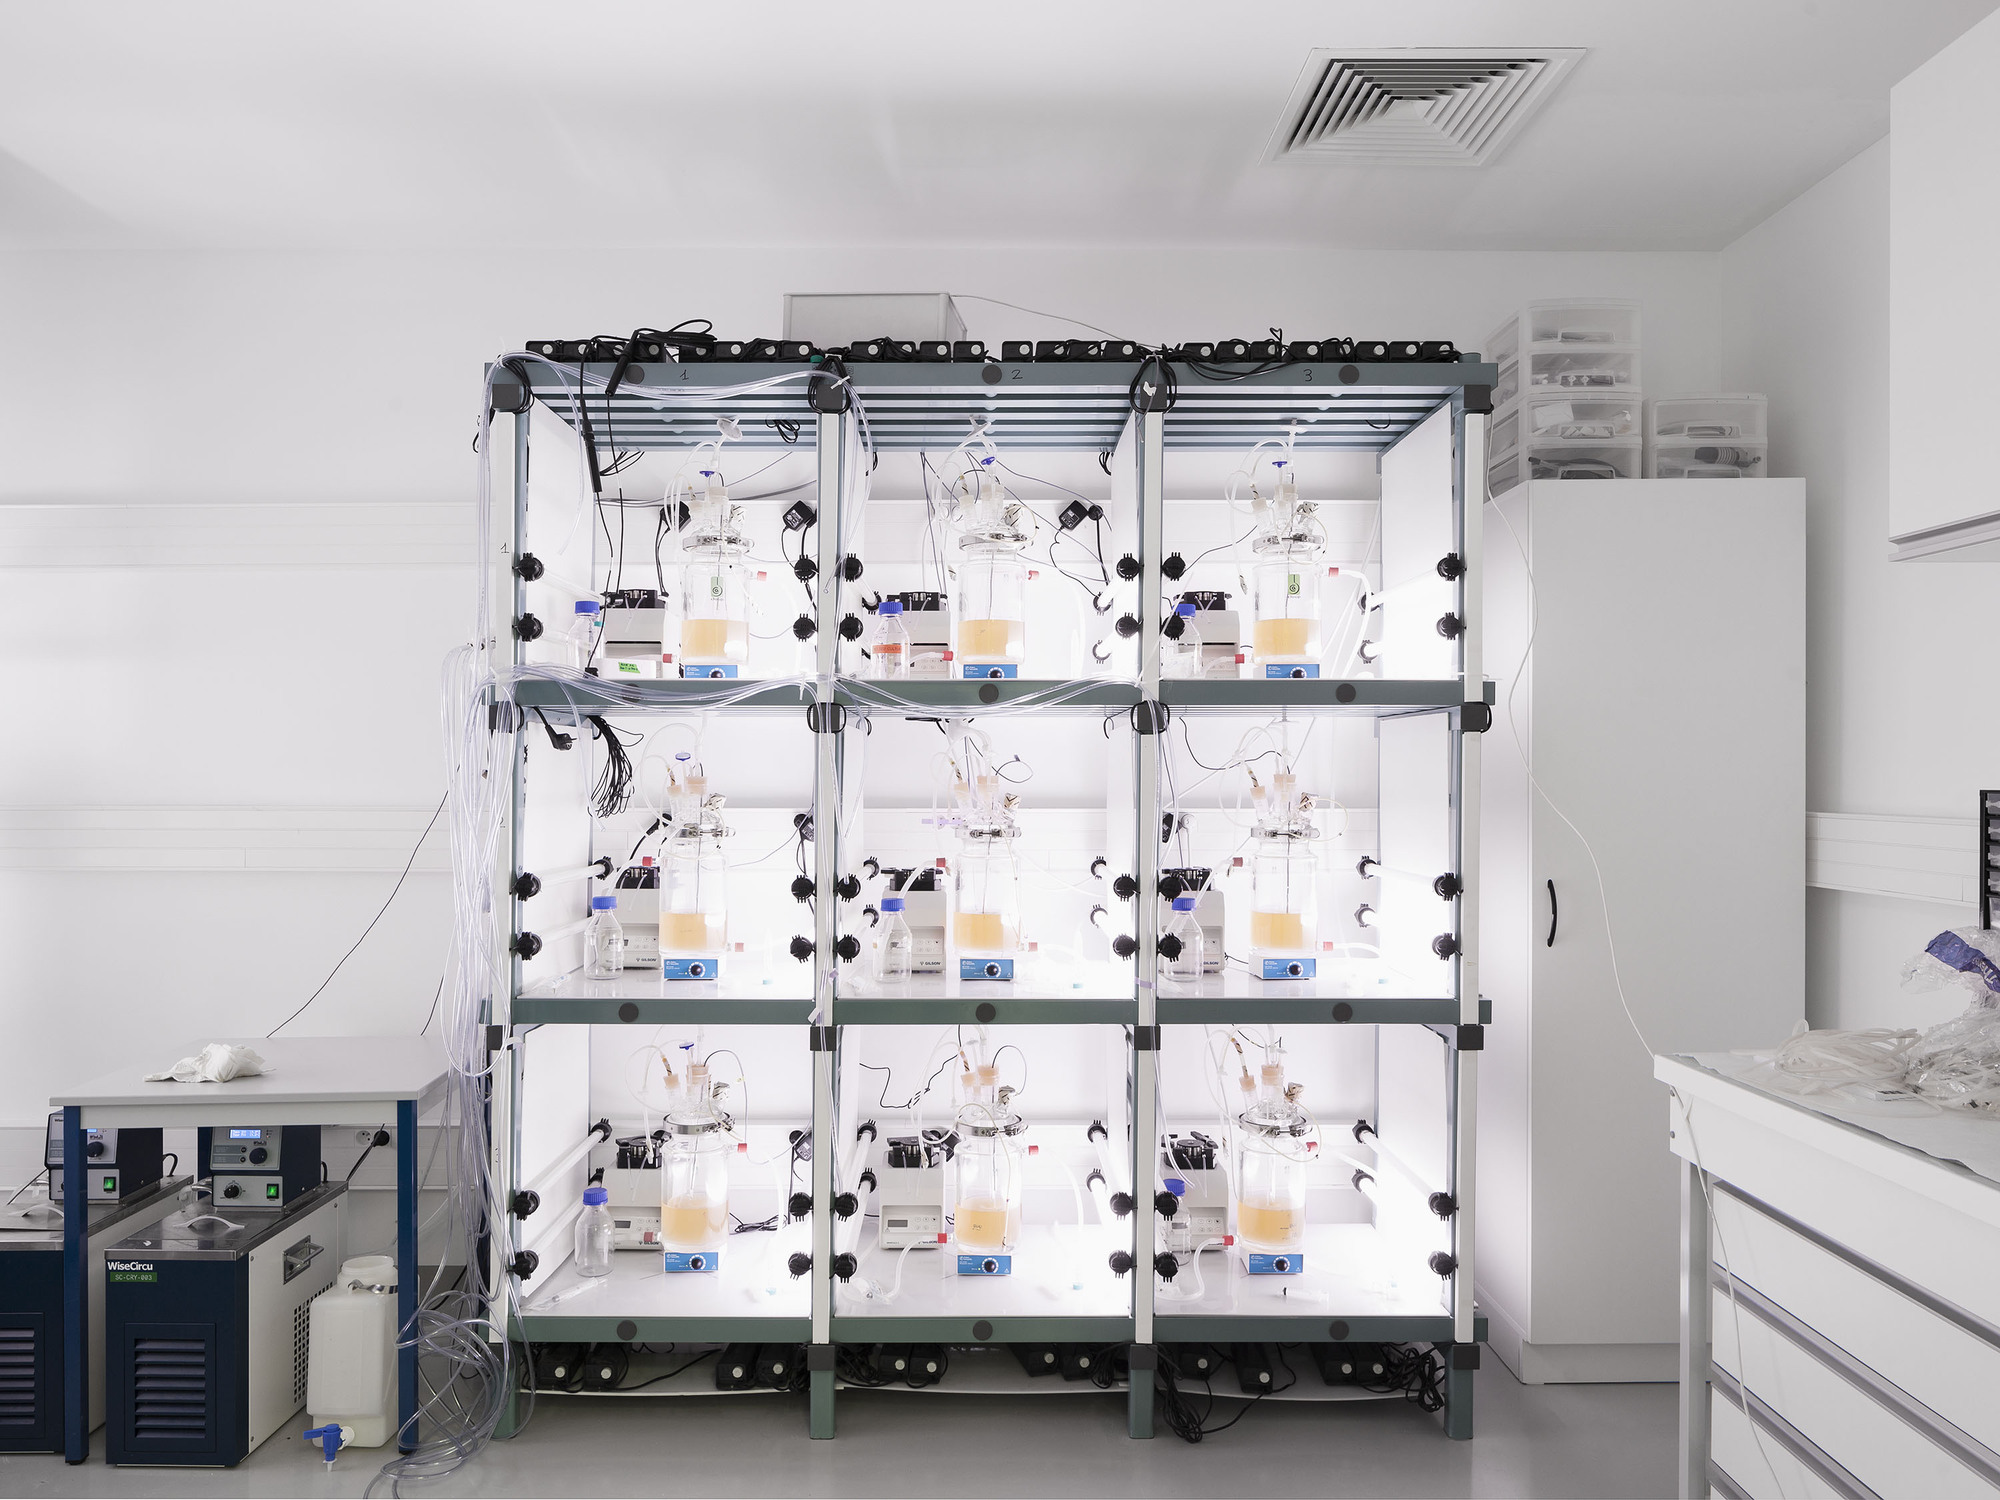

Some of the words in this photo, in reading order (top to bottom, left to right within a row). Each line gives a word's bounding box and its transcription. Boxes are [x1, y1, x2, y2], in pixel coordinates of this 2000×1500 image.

[679, 369, 689, 381] 1
[1011, 369, 1023, 380] 2
[1303, 368, 1313, 382] 3
[500, 542, 510, 553] 1
[107, 1261, 153, 1271] WiseCircu
